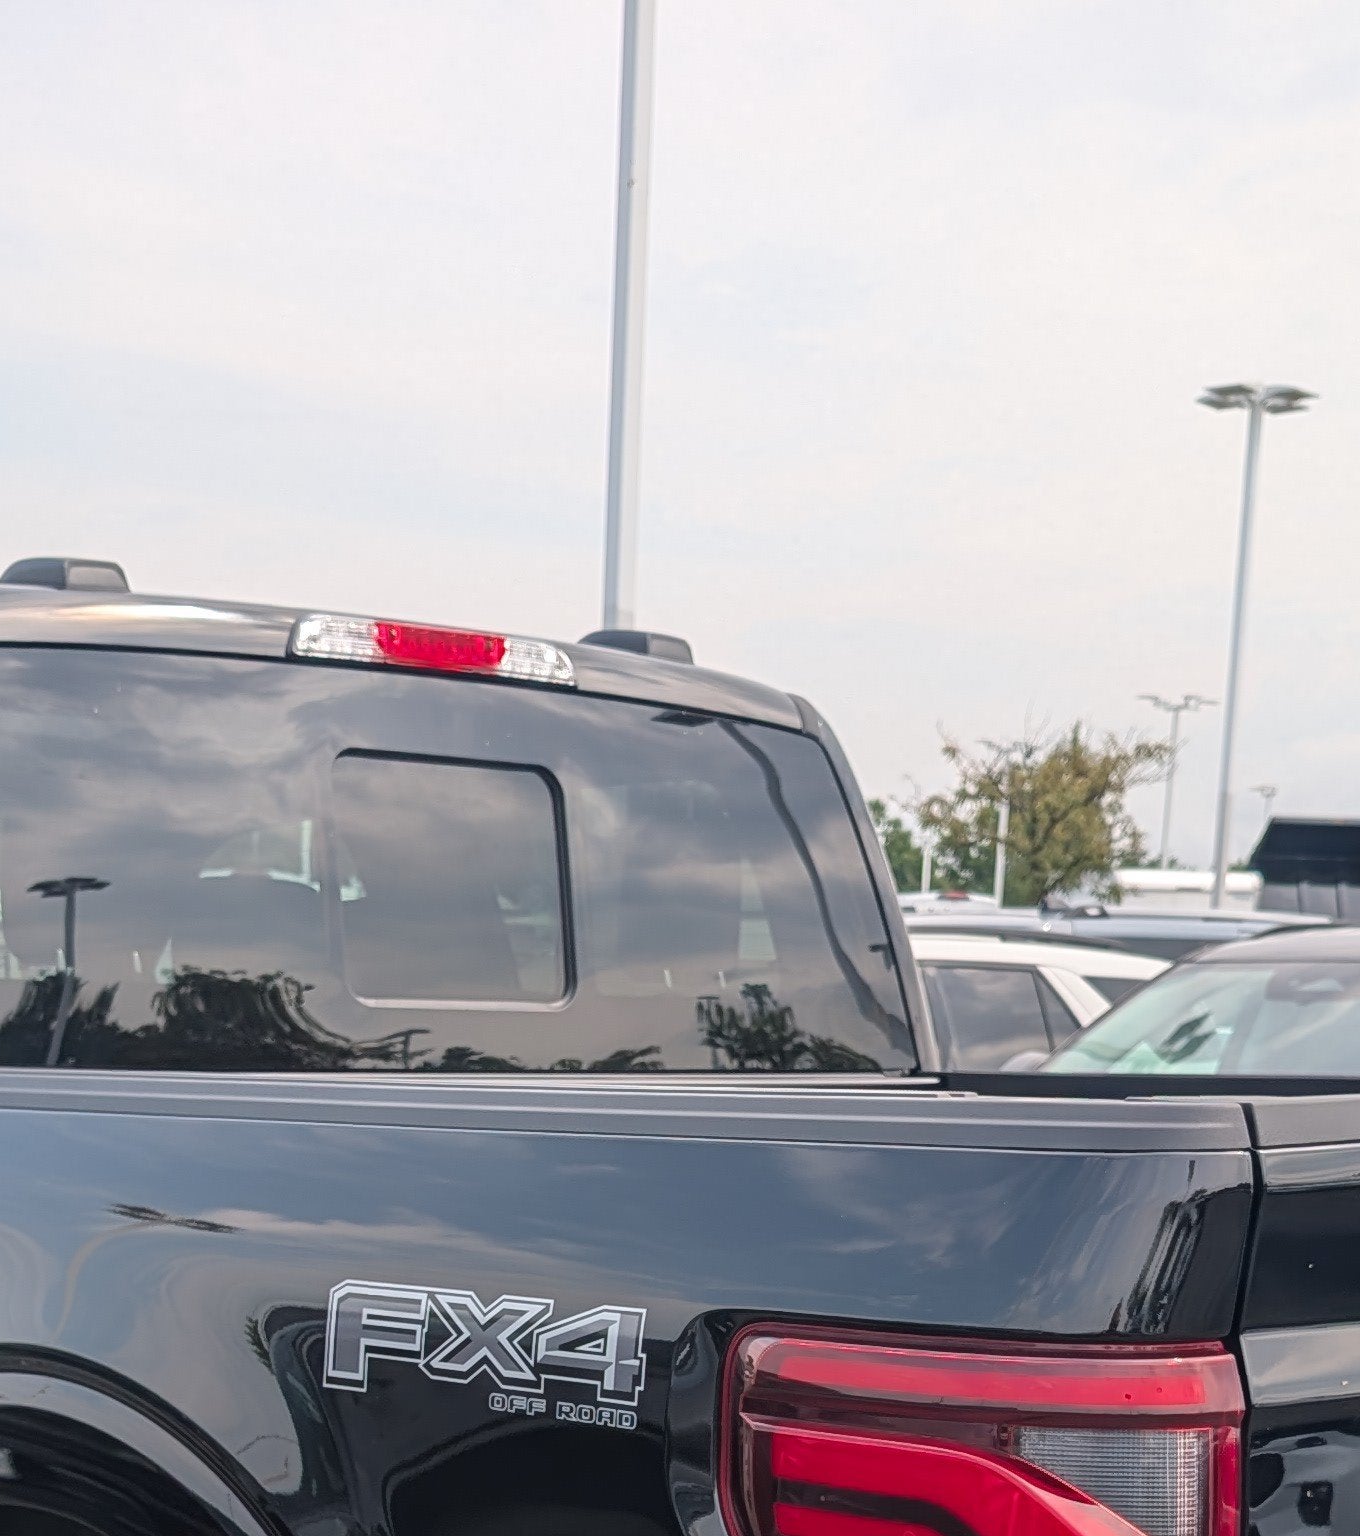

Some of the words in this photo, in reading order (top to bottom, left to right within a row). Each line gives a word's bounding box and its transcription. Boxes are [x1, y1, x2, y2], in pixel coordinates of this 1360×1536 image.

[323, 1279, 647, 1406] FX4
[488, 1392, 546, 1417] OFF
[556, 1402, 638, 1430] ROAD
